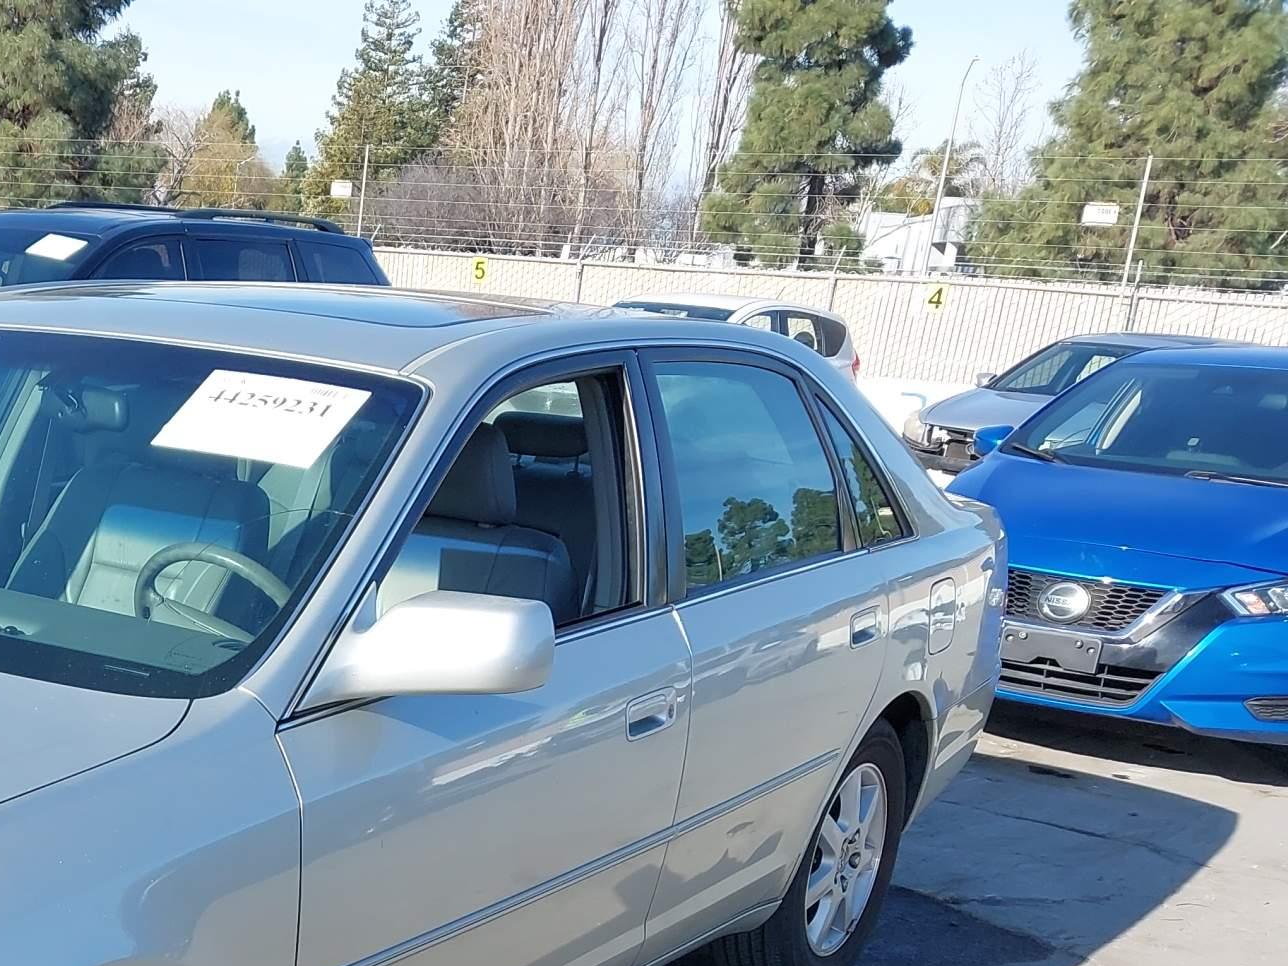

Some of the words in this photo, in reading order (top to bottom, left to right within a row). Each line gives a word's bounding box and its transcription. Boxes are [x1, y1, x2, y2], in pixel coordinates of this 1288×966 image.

[475, 261, 485, 280] 5
[927, 287, 943, 309] 4
[208, 389, 333, 417] 44259231
